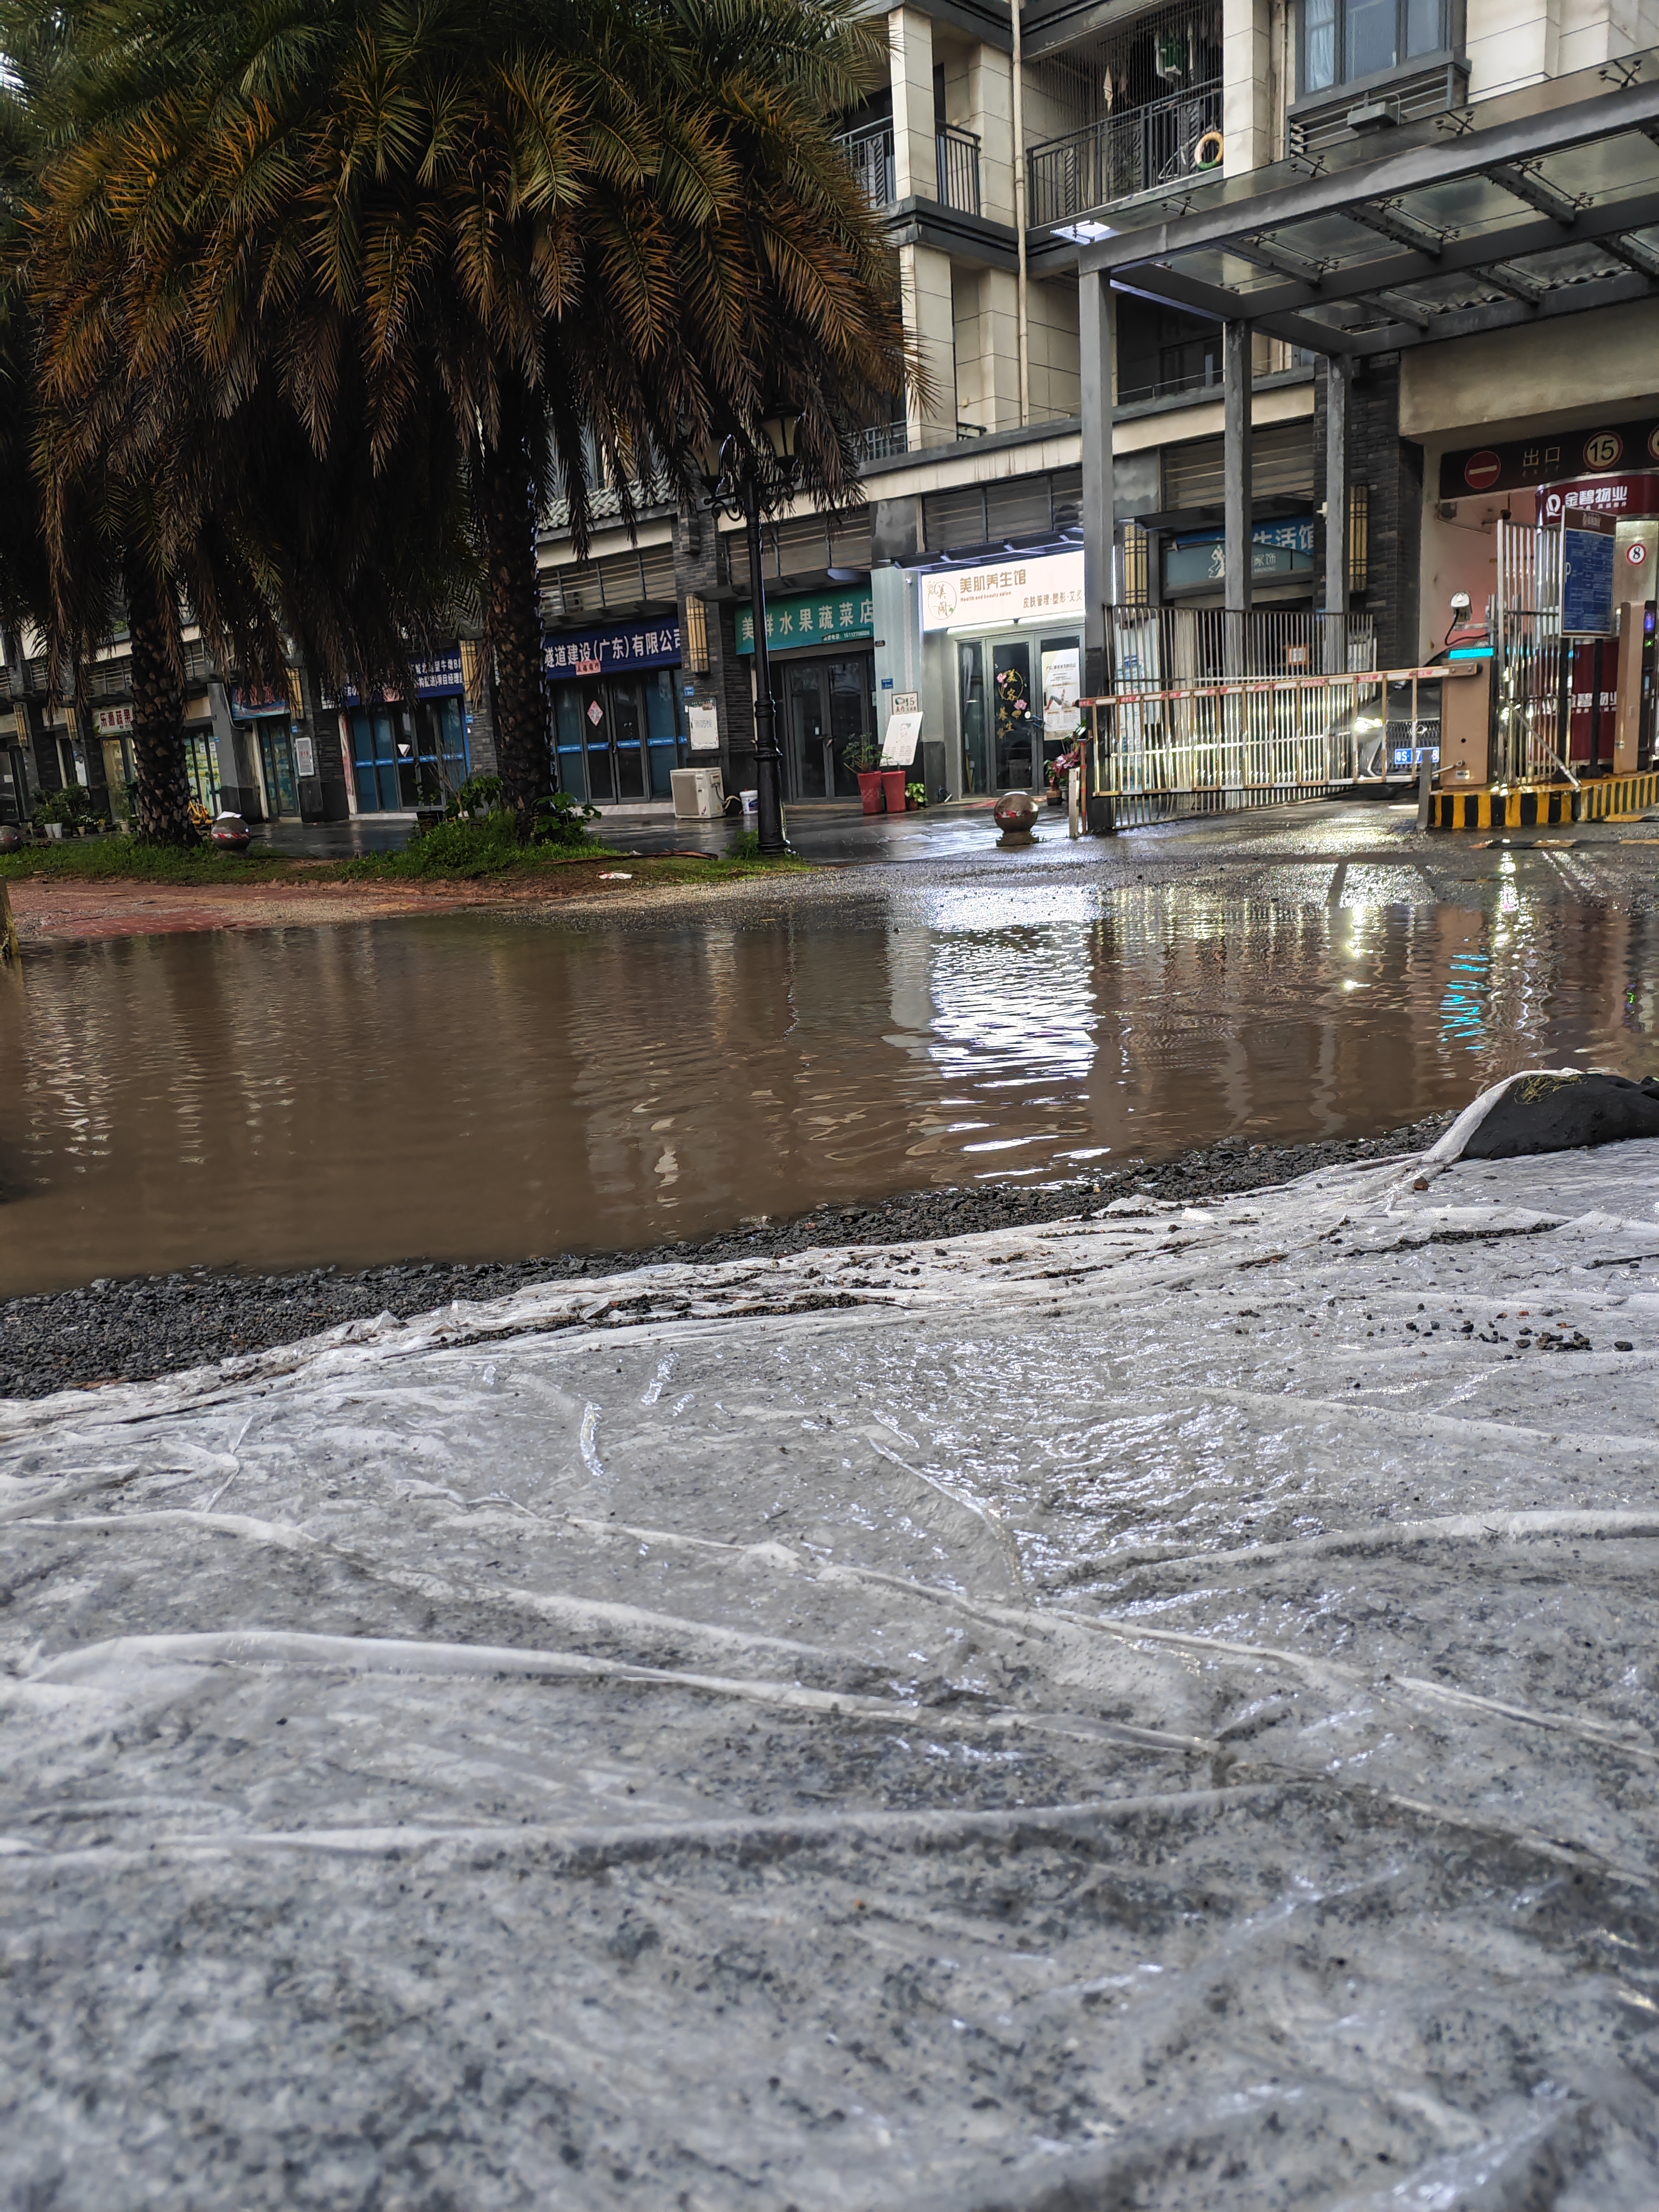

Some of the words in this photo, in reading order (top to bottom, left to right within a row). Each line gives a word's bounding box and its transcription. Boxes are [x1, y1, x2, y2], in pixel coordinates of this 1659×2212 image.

[1523, 446, 1560, 467] 出口
[1590, 439, 1614, 462] 15
[1565, 486, 1627, 507] 金碧物业
[1633, 547, 1641, 559] 8
[960, 569, 1027, 594] 美肌养生馆
